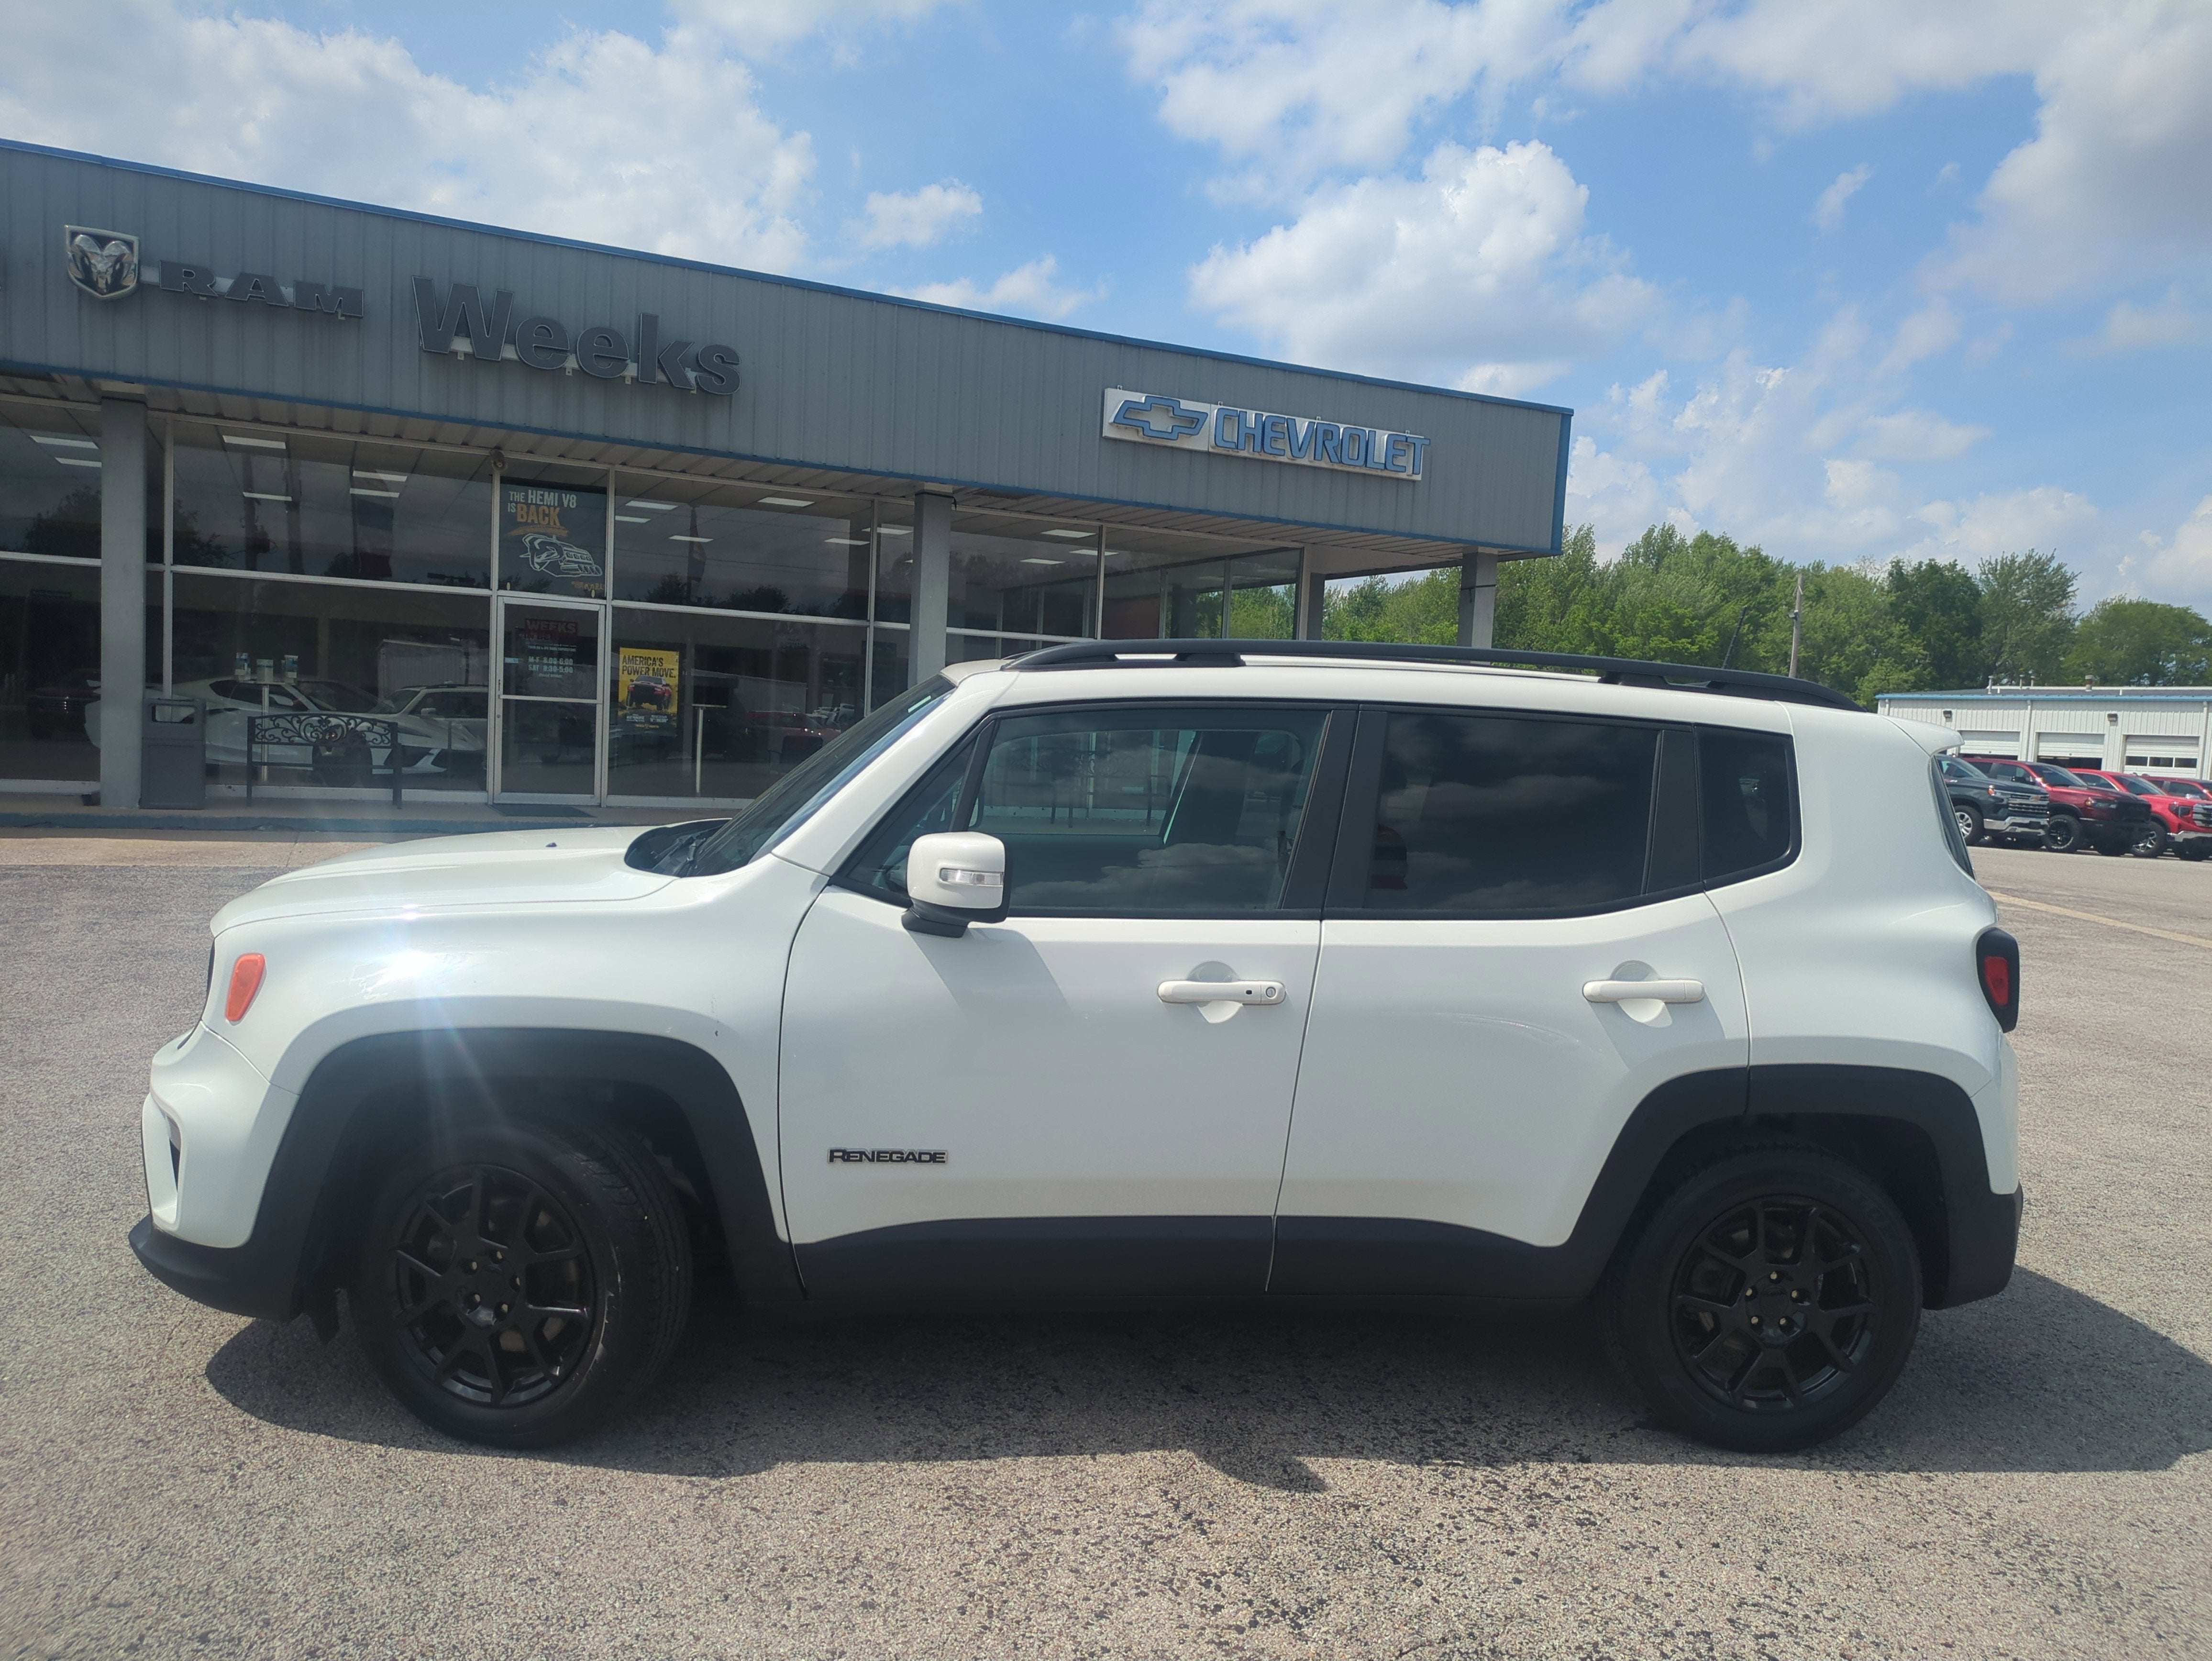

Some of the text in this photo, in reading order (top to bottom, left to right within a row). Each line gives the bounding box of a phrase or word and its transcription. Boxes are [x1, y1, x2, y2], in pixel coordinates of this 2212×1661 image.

[159, 260, 364, 318] RAM
[411, 276, 742, 396] Weeks
[1214, 407, 1431, 475] CHEVROLET
[509, 489, 577, 508] THE HEMI V8
[508, 502, 561, 528] IS BACK
[526, 620, 576, 634] WEEKS
[622, 655, 664, 667] AMERICA'S
[621, 665, 676, 678] POWER MOVE.
[828, 1148, 948, 1164] RENEGADE
